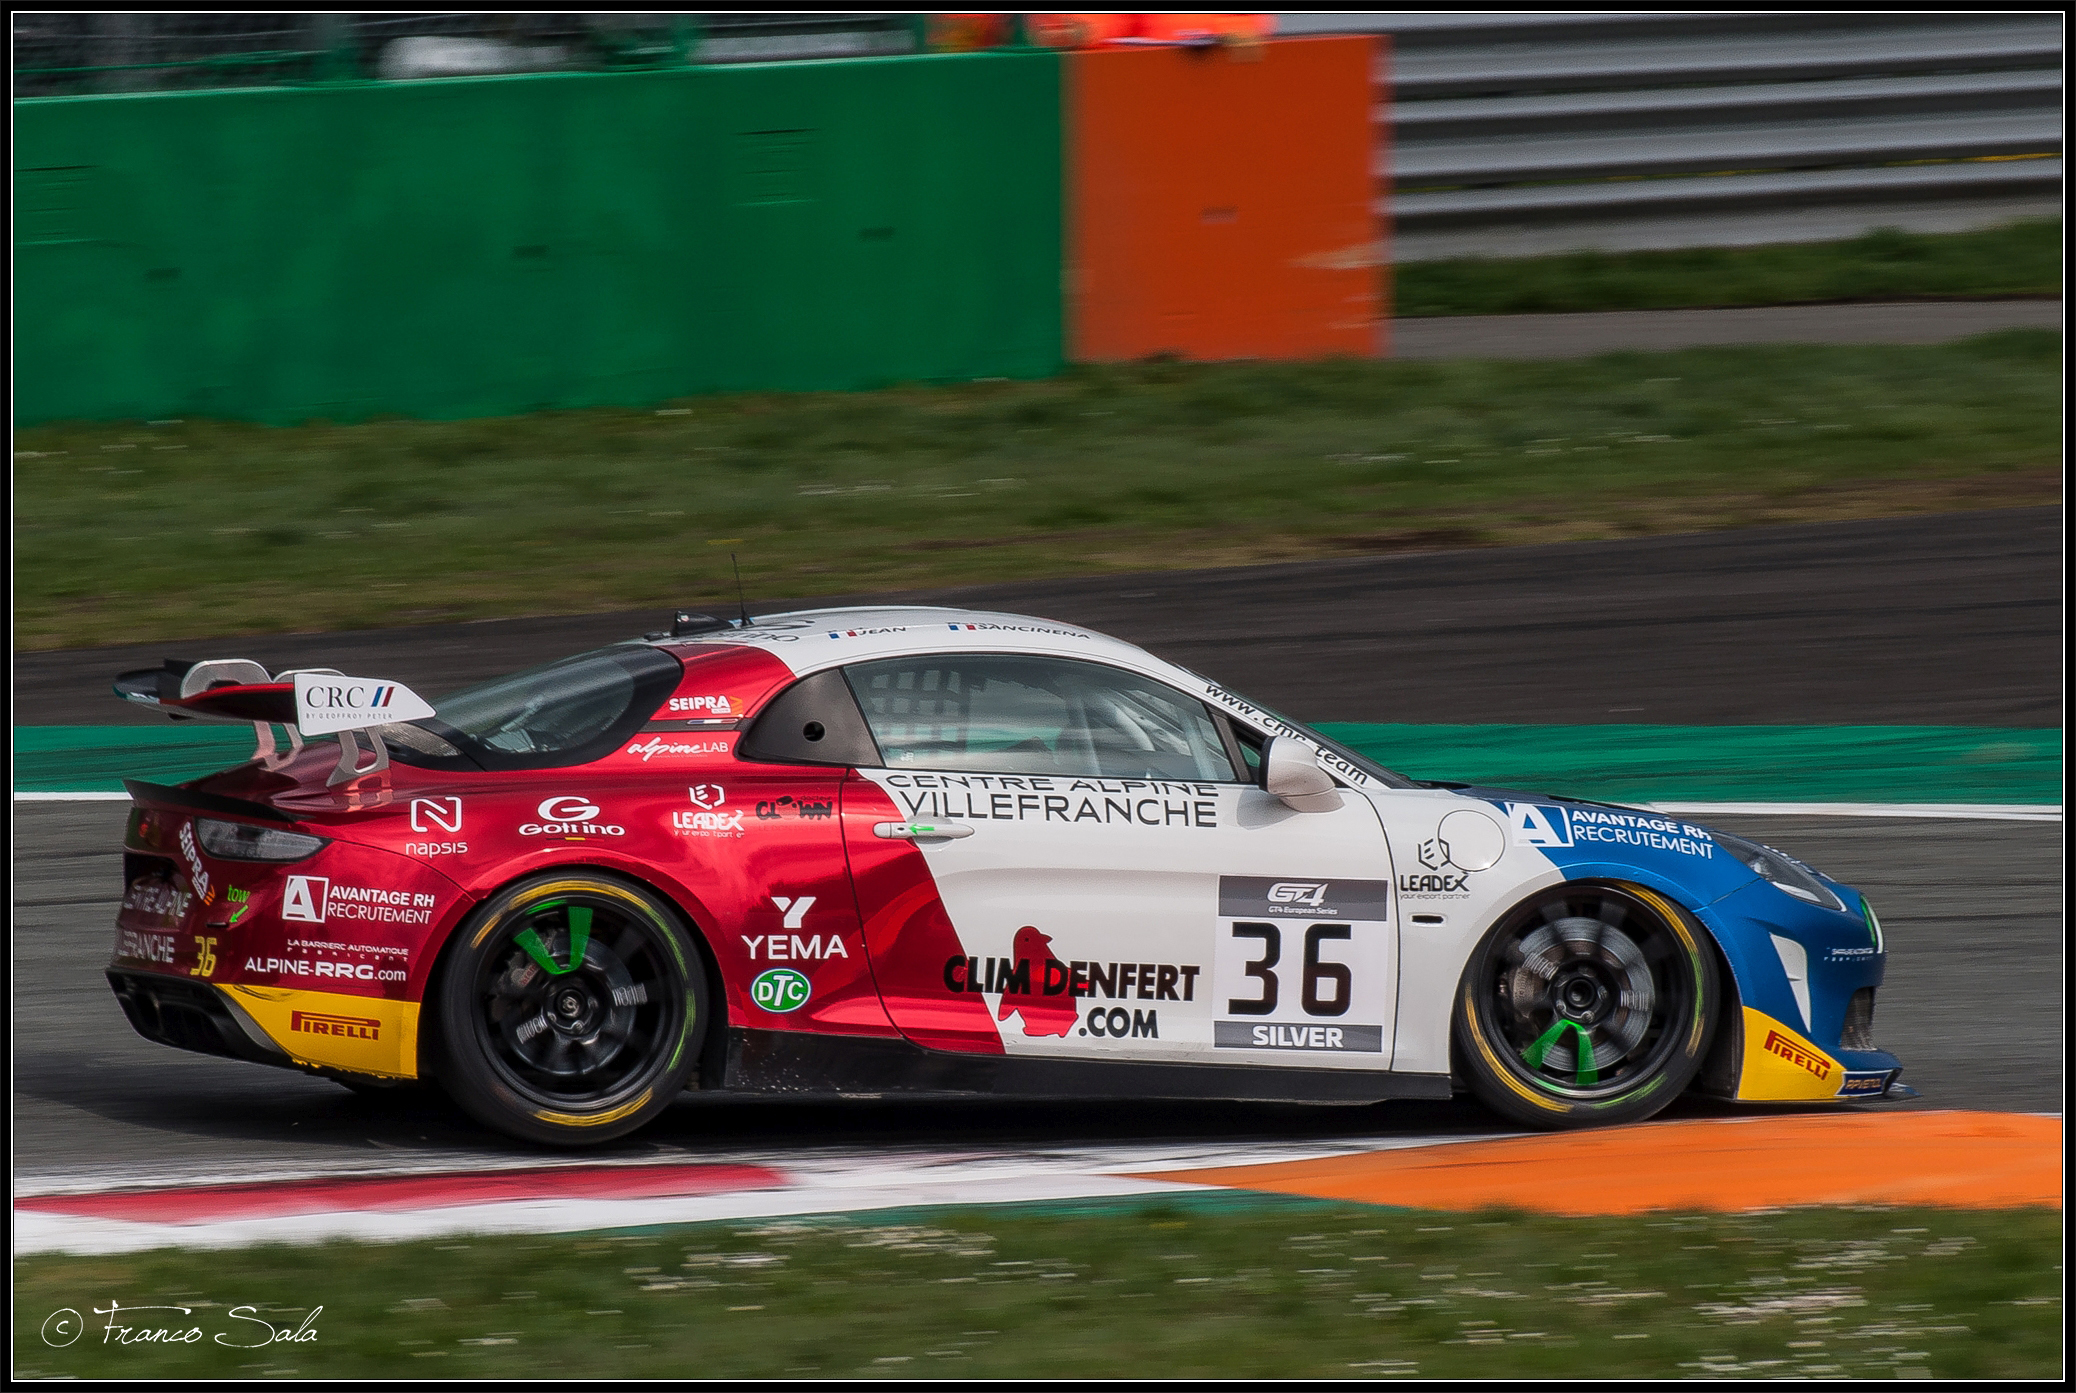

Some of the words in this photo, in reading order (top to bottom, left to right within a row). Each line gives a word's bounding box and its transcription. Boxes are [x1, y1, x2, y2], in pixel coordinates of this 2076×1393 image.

[858, 627, 906, 636] JEAN
[977, 623, 1091, 639] SANCINENA
[306, 686, 365, 708] CRC
[669, 695, 730, 711] SEIPRA
[886, 774, 1055, 792] CENTRE
[1069, 779, 1220, 798] ALPINE
[672, 809, 744, 830] LEADEX
[899, 791, 1218, 828] VILLEFRANCHE
[1572, 810, 1679, 834] AVANTAGE
[405, 841, 468, 859] napsis
[1573, 825, 1714, 859] RECRUTEMENT
[227, 884, 250, 903] tow
[1400, 871, 1470, 892] LEADEX
[329, 885, 411, 906] AVANTAGE
[413, 894, 435, 908] RH
[1267, 882, 1329, 906] GT4
[327, 902, 432, 925] RECRUTEMENT
[1268, 905, 1283, 913] GT4
[1283, 906, 1316, 915] European
[1316, 907, 1338, 915] Series
[190, 935, 218, 977] 36
[287, 939, 300, 947] LA
[347, 944, 409, 956] AUTOMATIQUE
[741, 934, 848, 960] YEMA
[244, 956, 407, 982] ALPINE-RRG.com
[943, 955, 1031, 996] CLIM
[1042, 958, 1201, 1002] DENFERT
[1227, 921, 1352, 1018] 36
[758, 974, 804, 1007] DTC
[291, 1010, 381, 1041] PIRELLI
[1078, 1006, 1160, 1039] .COM
[1251, 1025, 1345, 1048] SILVER
[1764, 1030, 1831, 1080] PIRELLI
